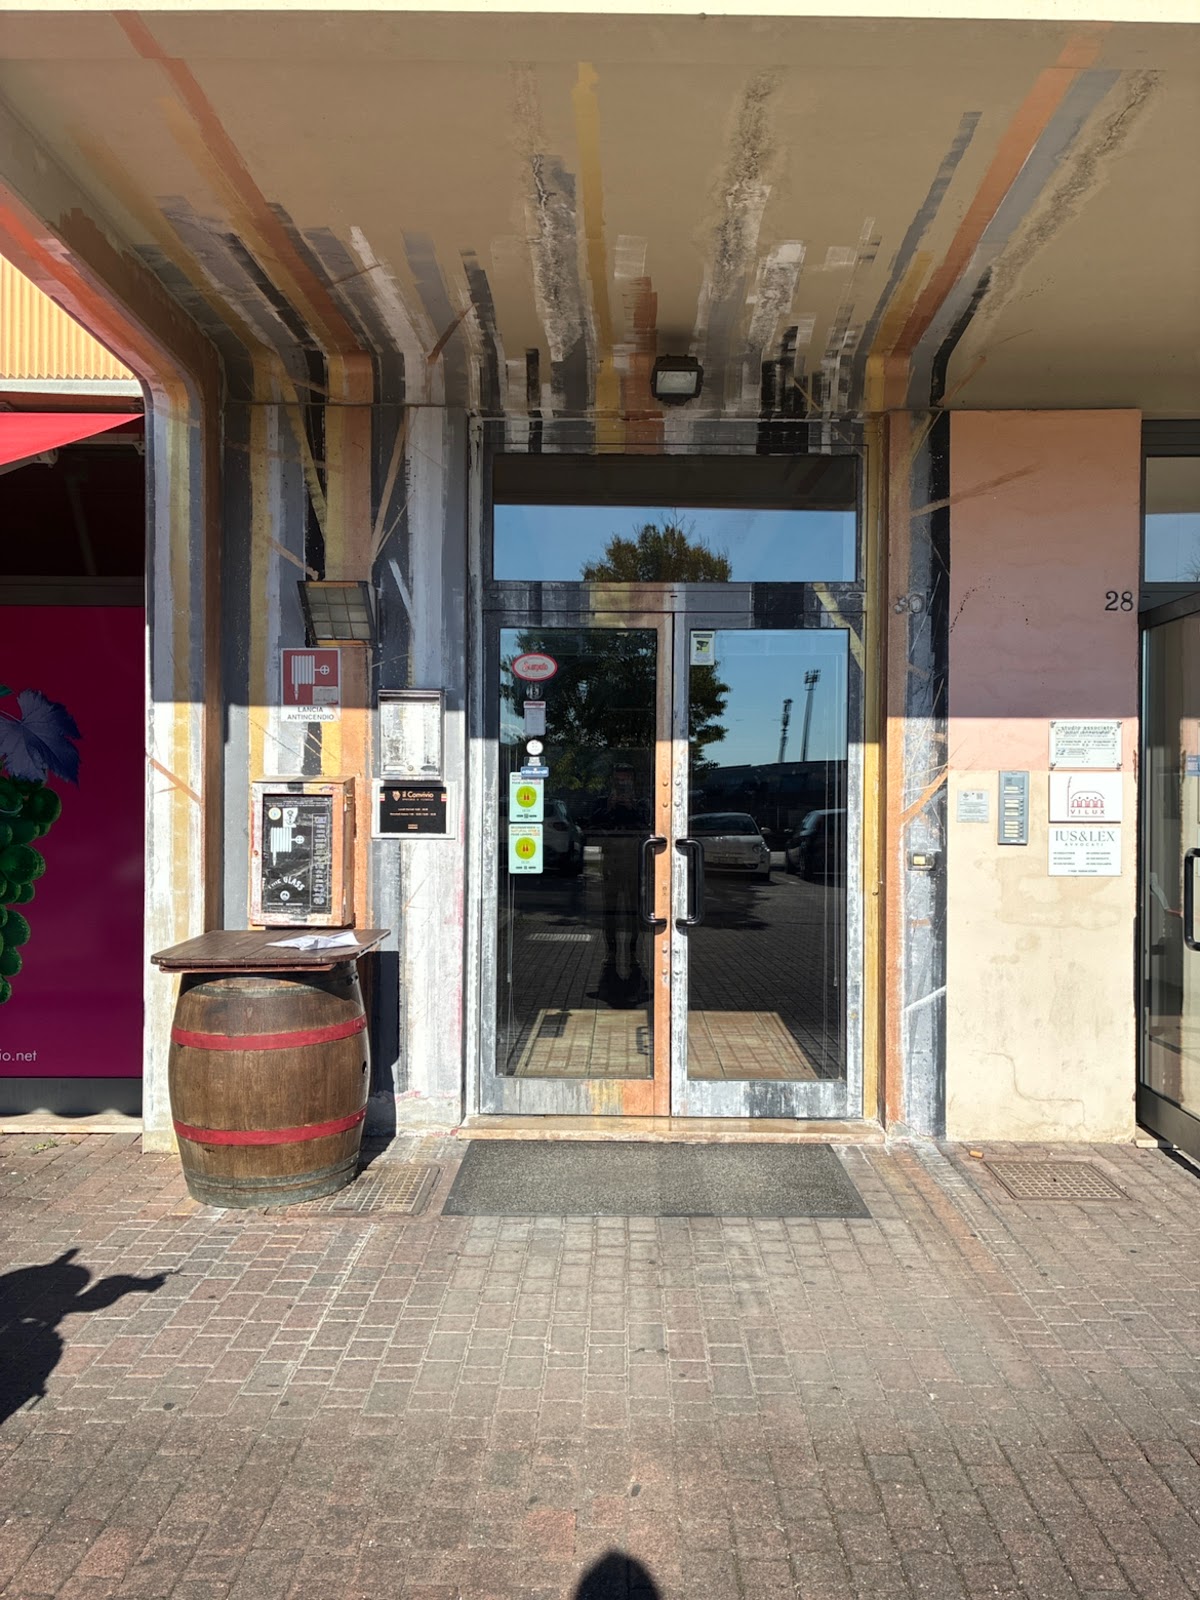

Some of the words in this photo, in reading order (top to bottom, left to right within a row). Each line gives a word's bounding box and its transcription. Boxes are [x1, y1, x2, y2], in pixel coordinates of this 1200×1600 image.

[1105, 591, 1134, 612] 28
[1055, 830, 1115, 842] IUS&LEX
[282, 875, 305, 891] GLASS
